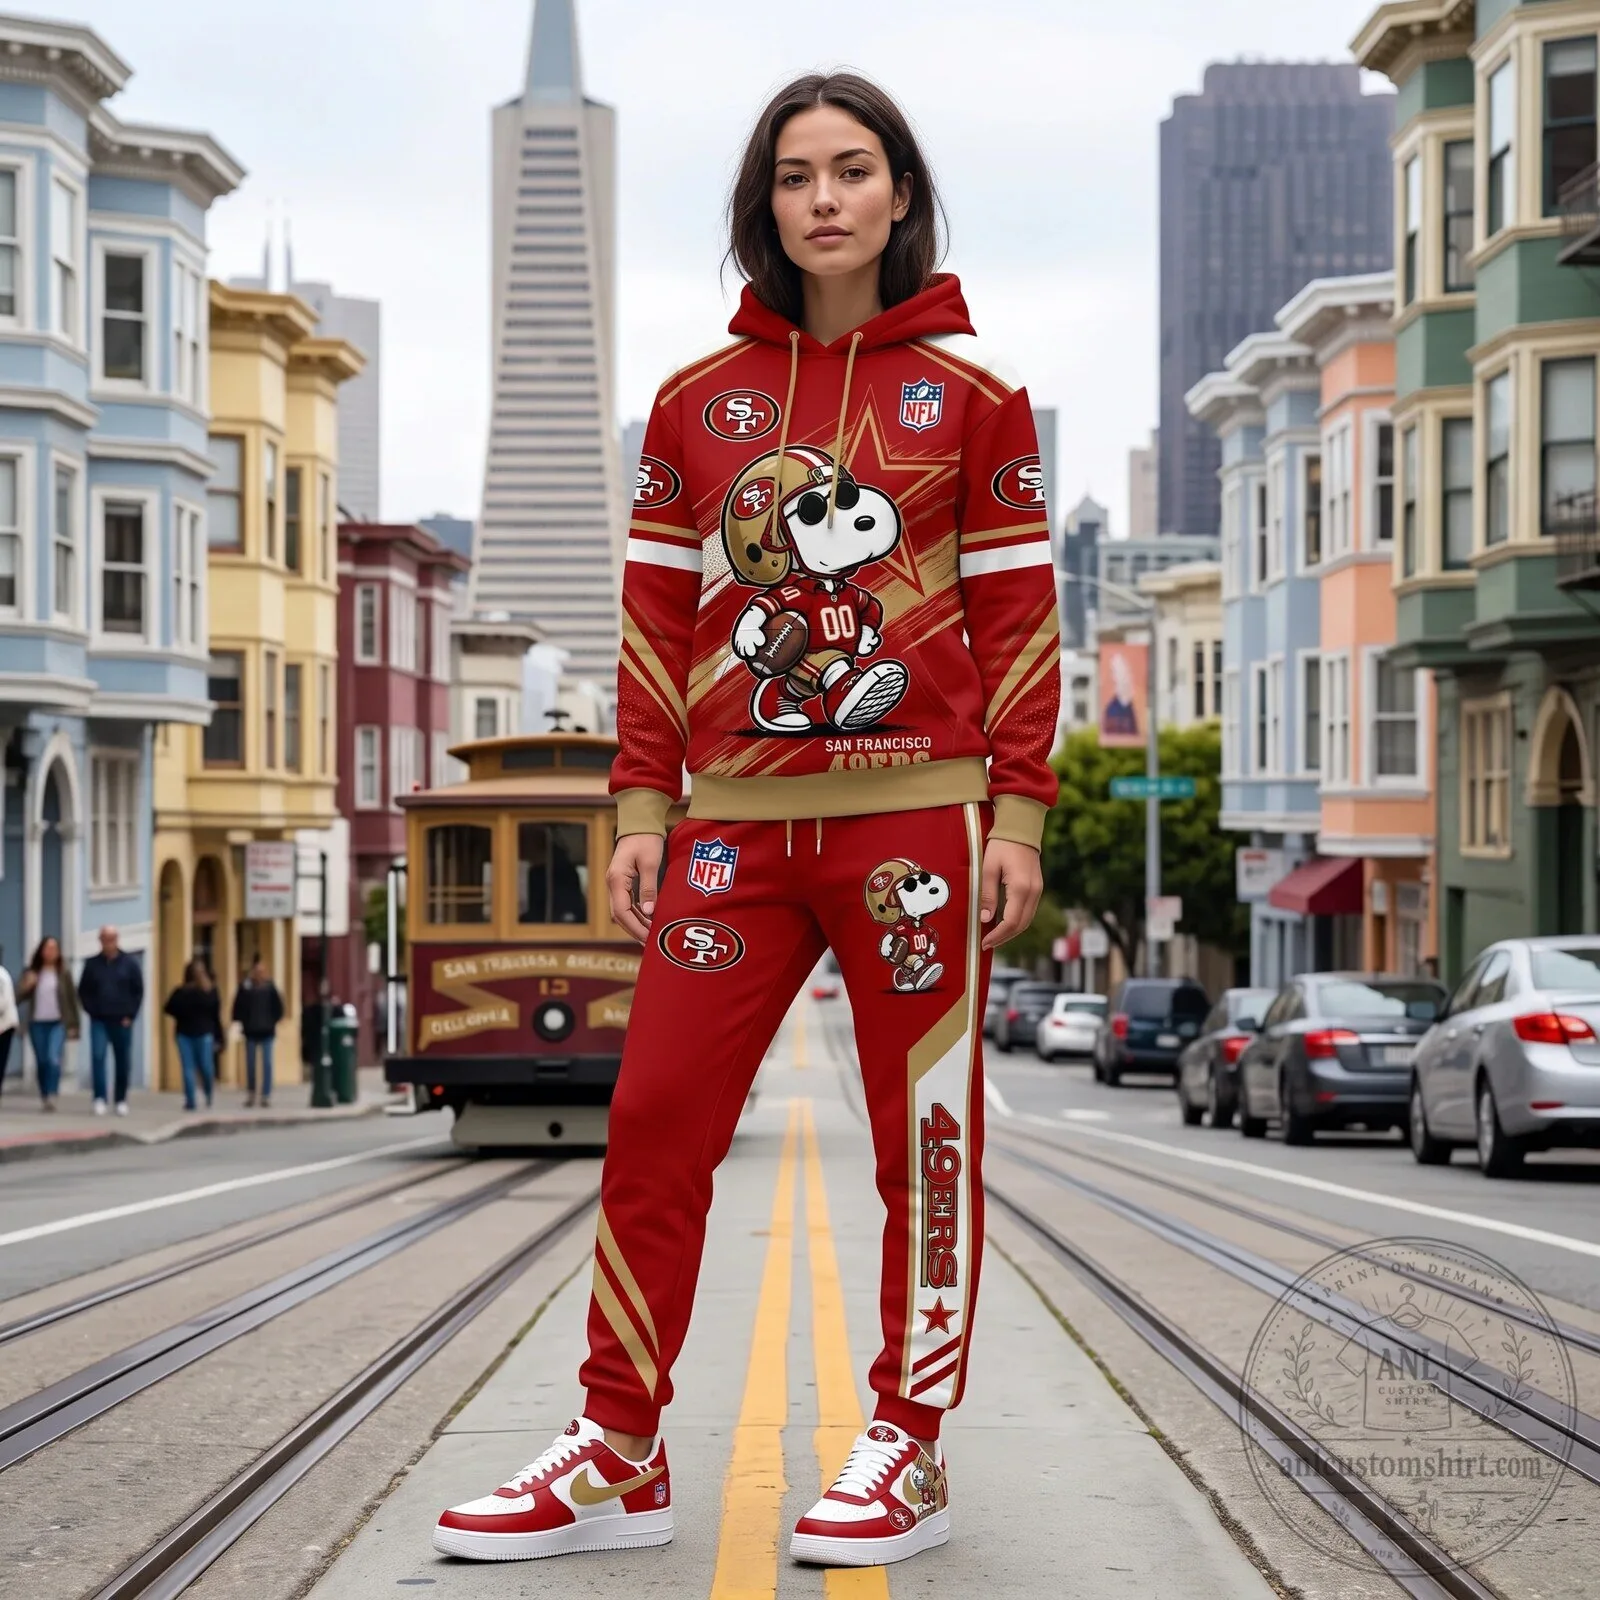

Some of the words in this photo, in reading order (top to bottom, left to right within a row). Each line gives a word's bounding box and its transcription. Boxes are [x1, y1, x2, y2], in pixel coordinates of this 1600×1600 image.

[904, 402, 936, 423] NFL
[820, 604, 856, 642] 00
[825, 739, 852, 752] SAN
[856, 736, 932, 751] FRANCISCO
[692, 860, 729, 889] NFL
[913, 933, 928, 950] 00
[920, 1102, 962, 1288] 49ERS
